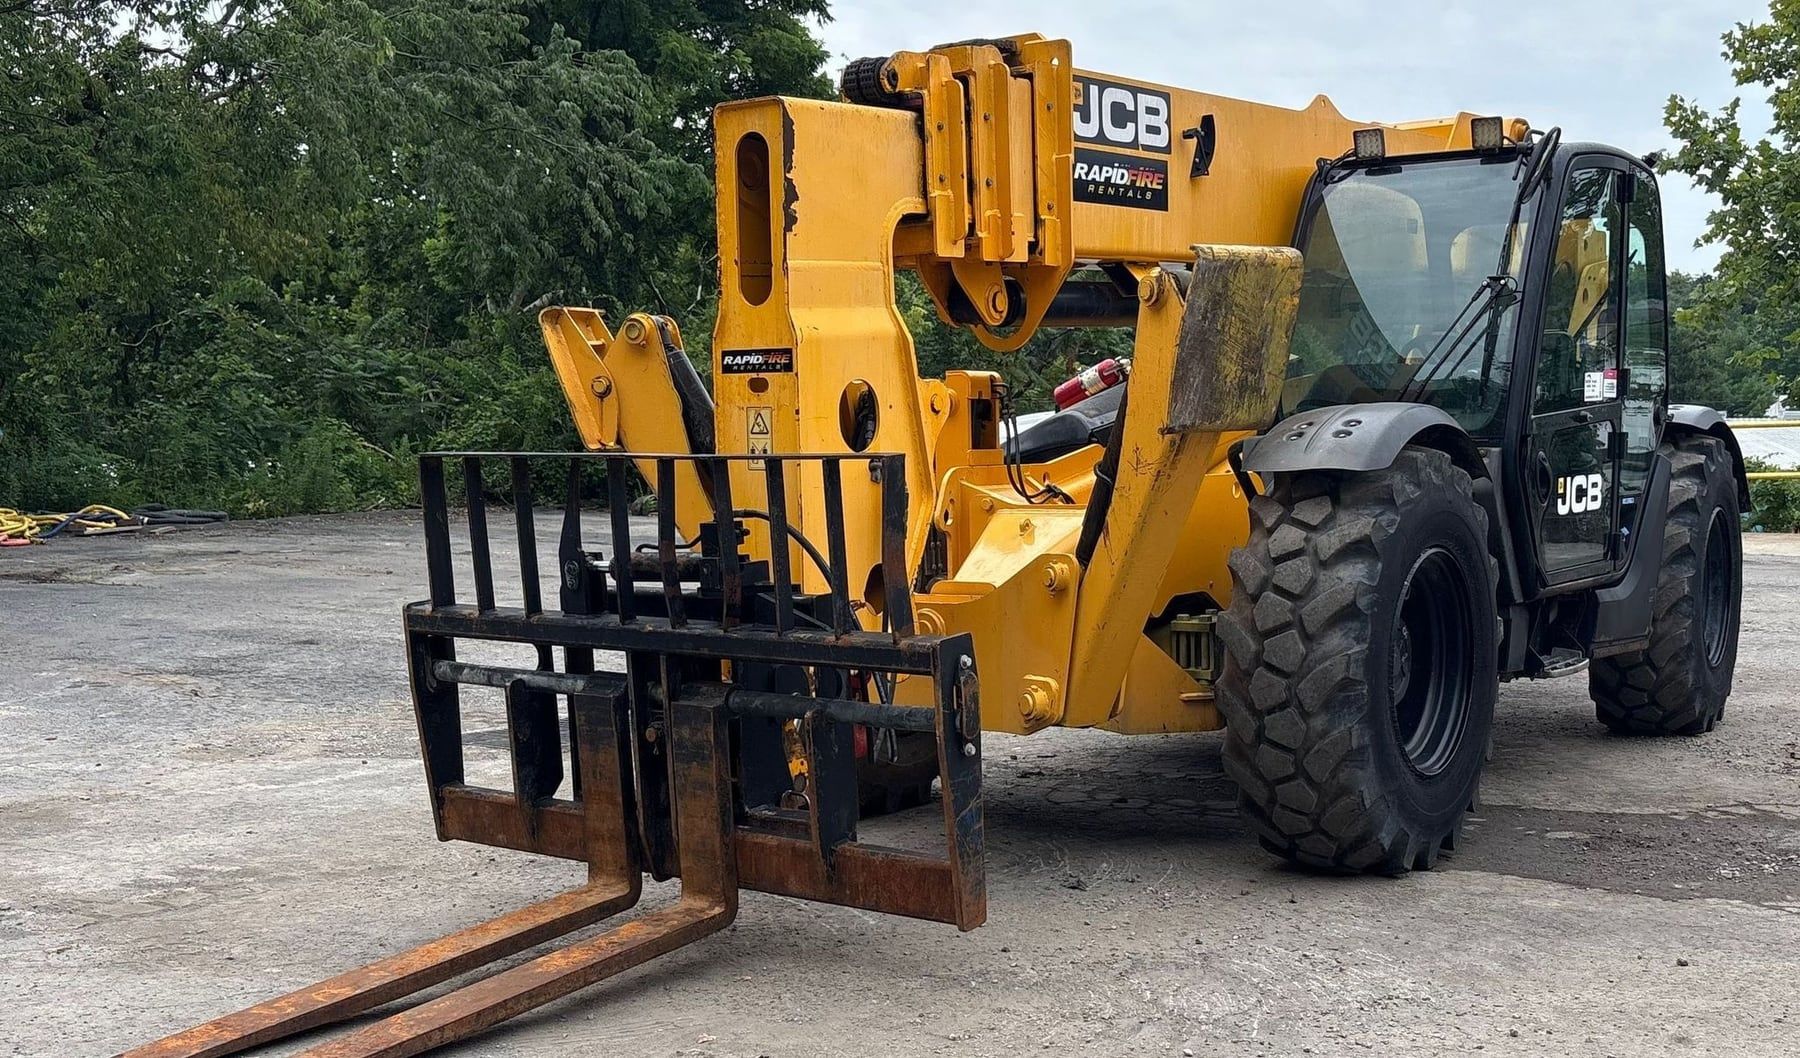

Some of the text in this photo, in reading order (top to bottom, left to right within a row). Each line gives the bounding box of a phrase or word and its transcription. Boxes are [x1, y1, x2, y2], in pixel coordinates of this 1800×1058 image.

[1073, 84, 1169, 148] JCB
[1087, 184, 1153, 200] RENTALS
[1557, 473, 1603, 516] JCB
